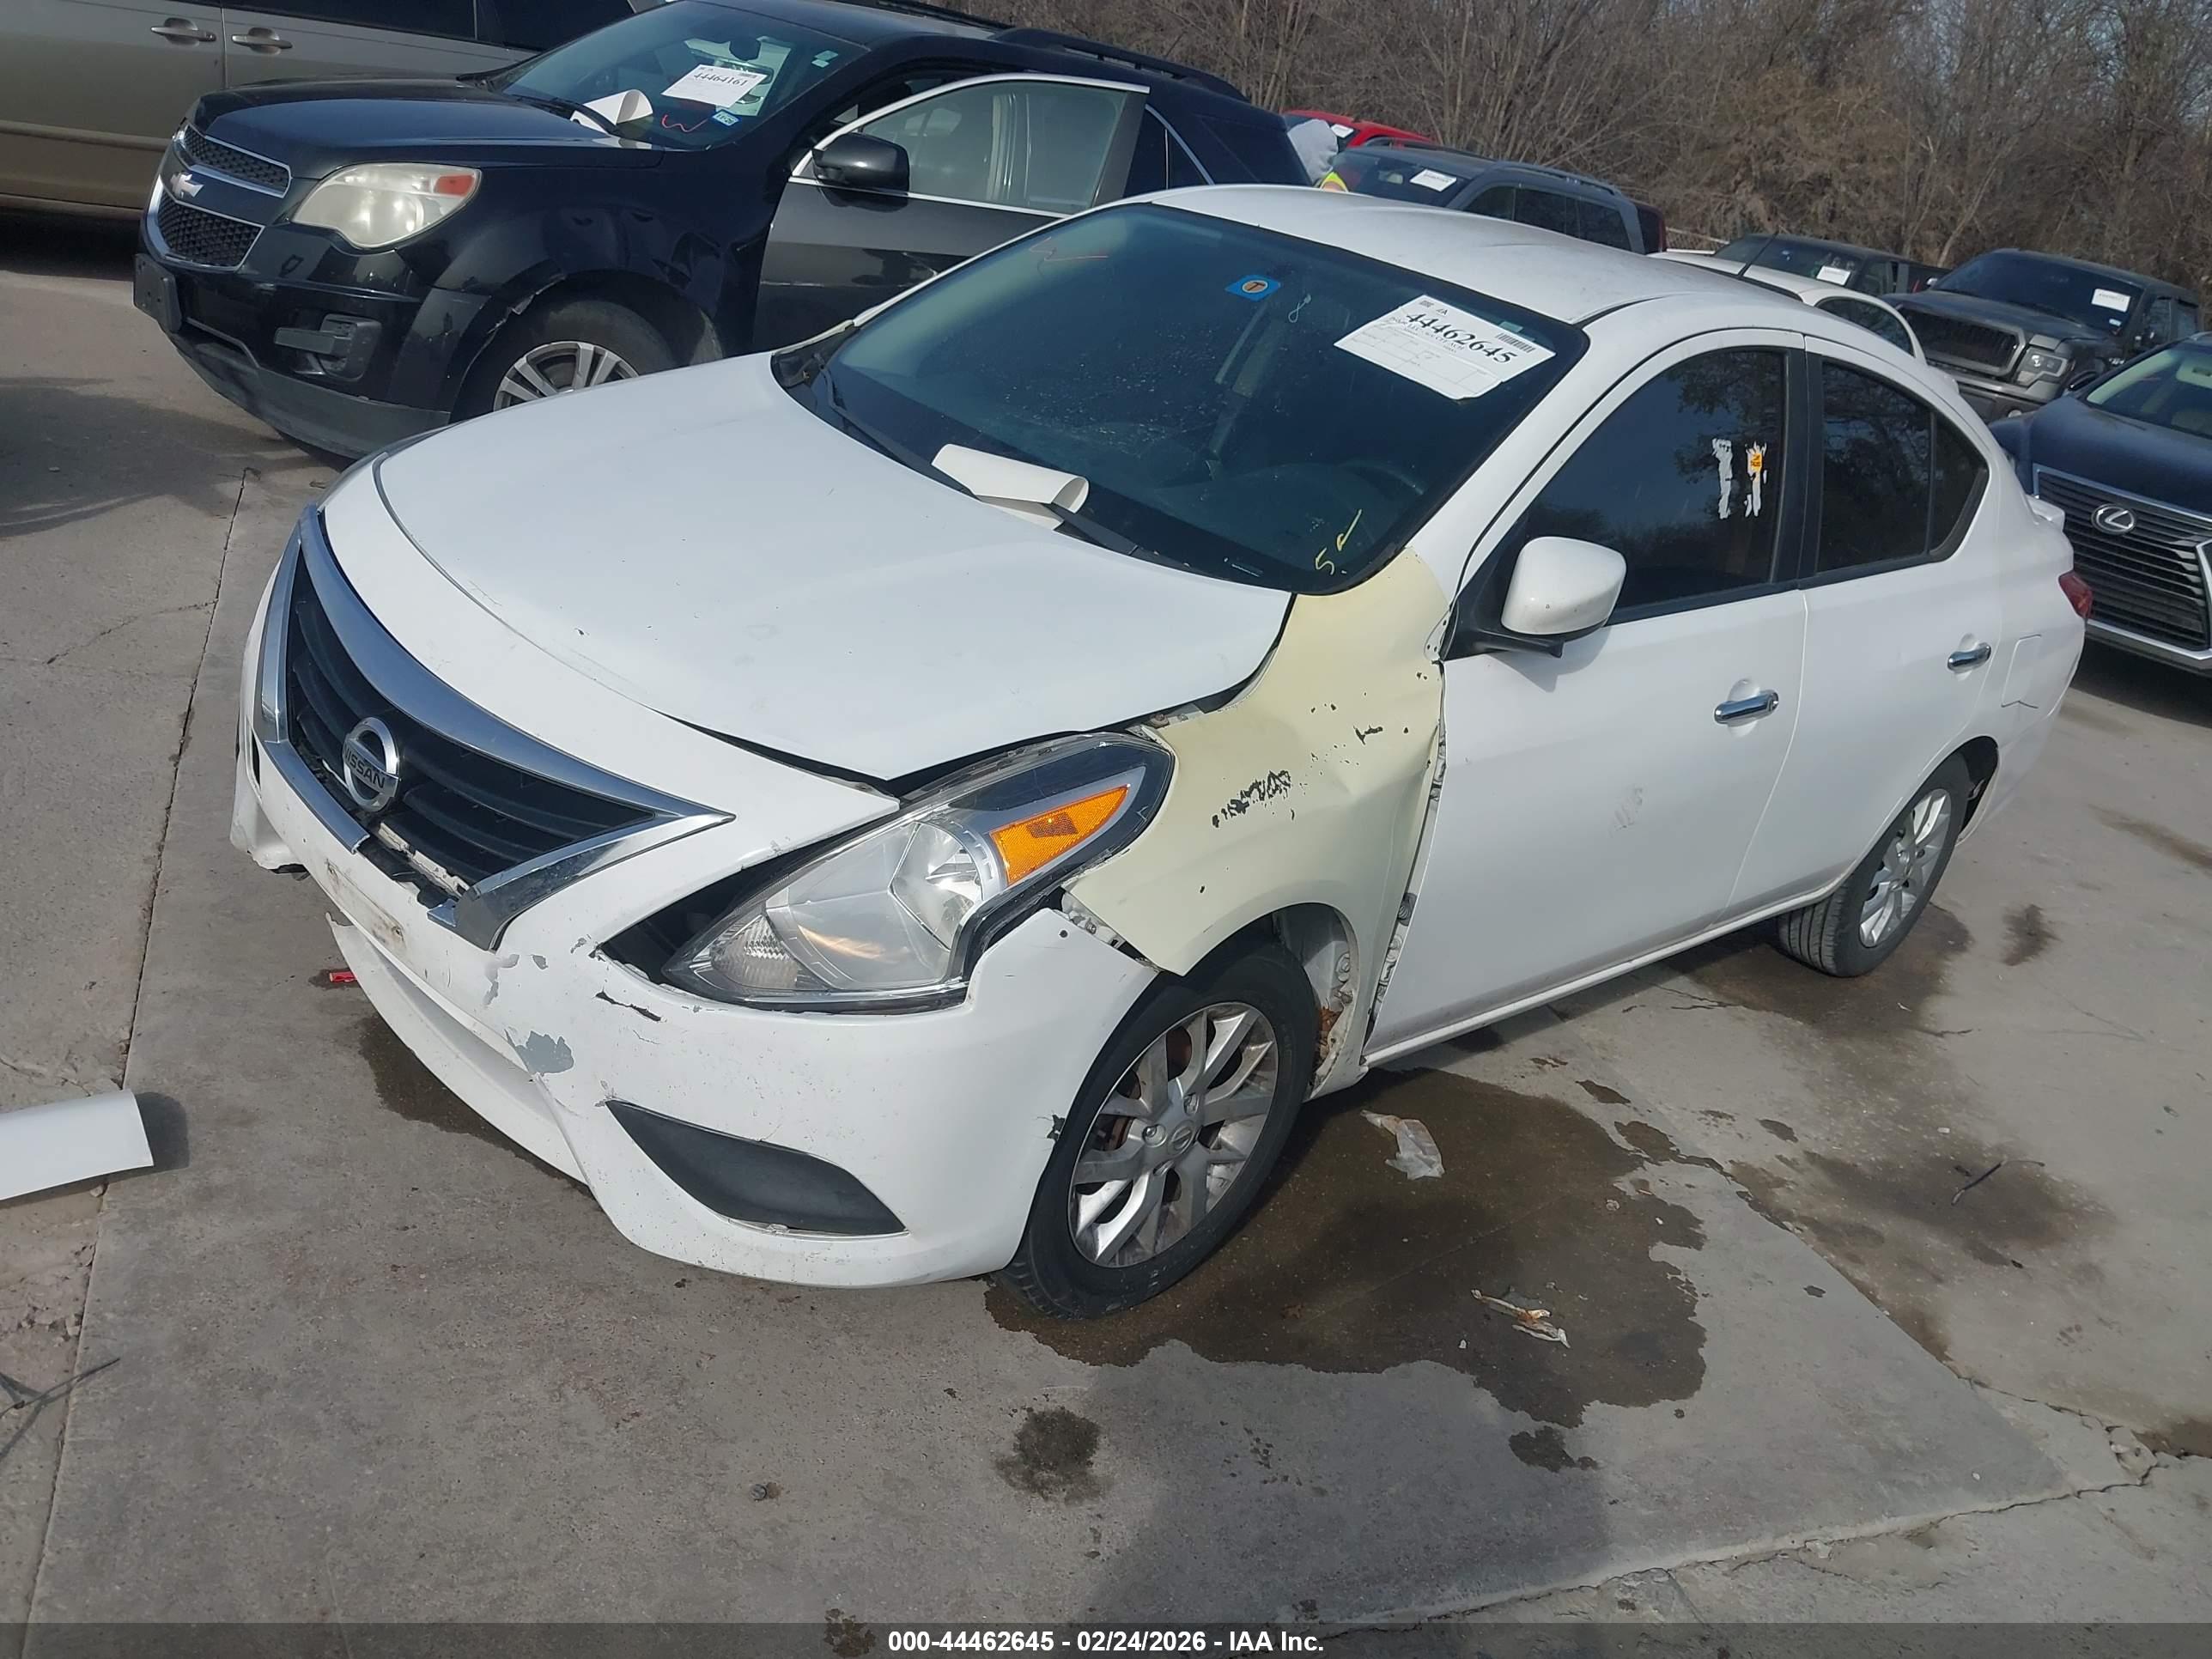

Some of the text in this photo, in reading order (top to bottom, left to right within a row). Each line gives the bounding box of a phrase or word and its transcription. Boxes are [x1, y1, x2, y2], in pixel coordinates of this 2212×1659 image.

[694, 72, 749, 87] 44464161
[1405, 313, 1518, 365] 44462645
[343, 746, 386, 788] NISSAN
